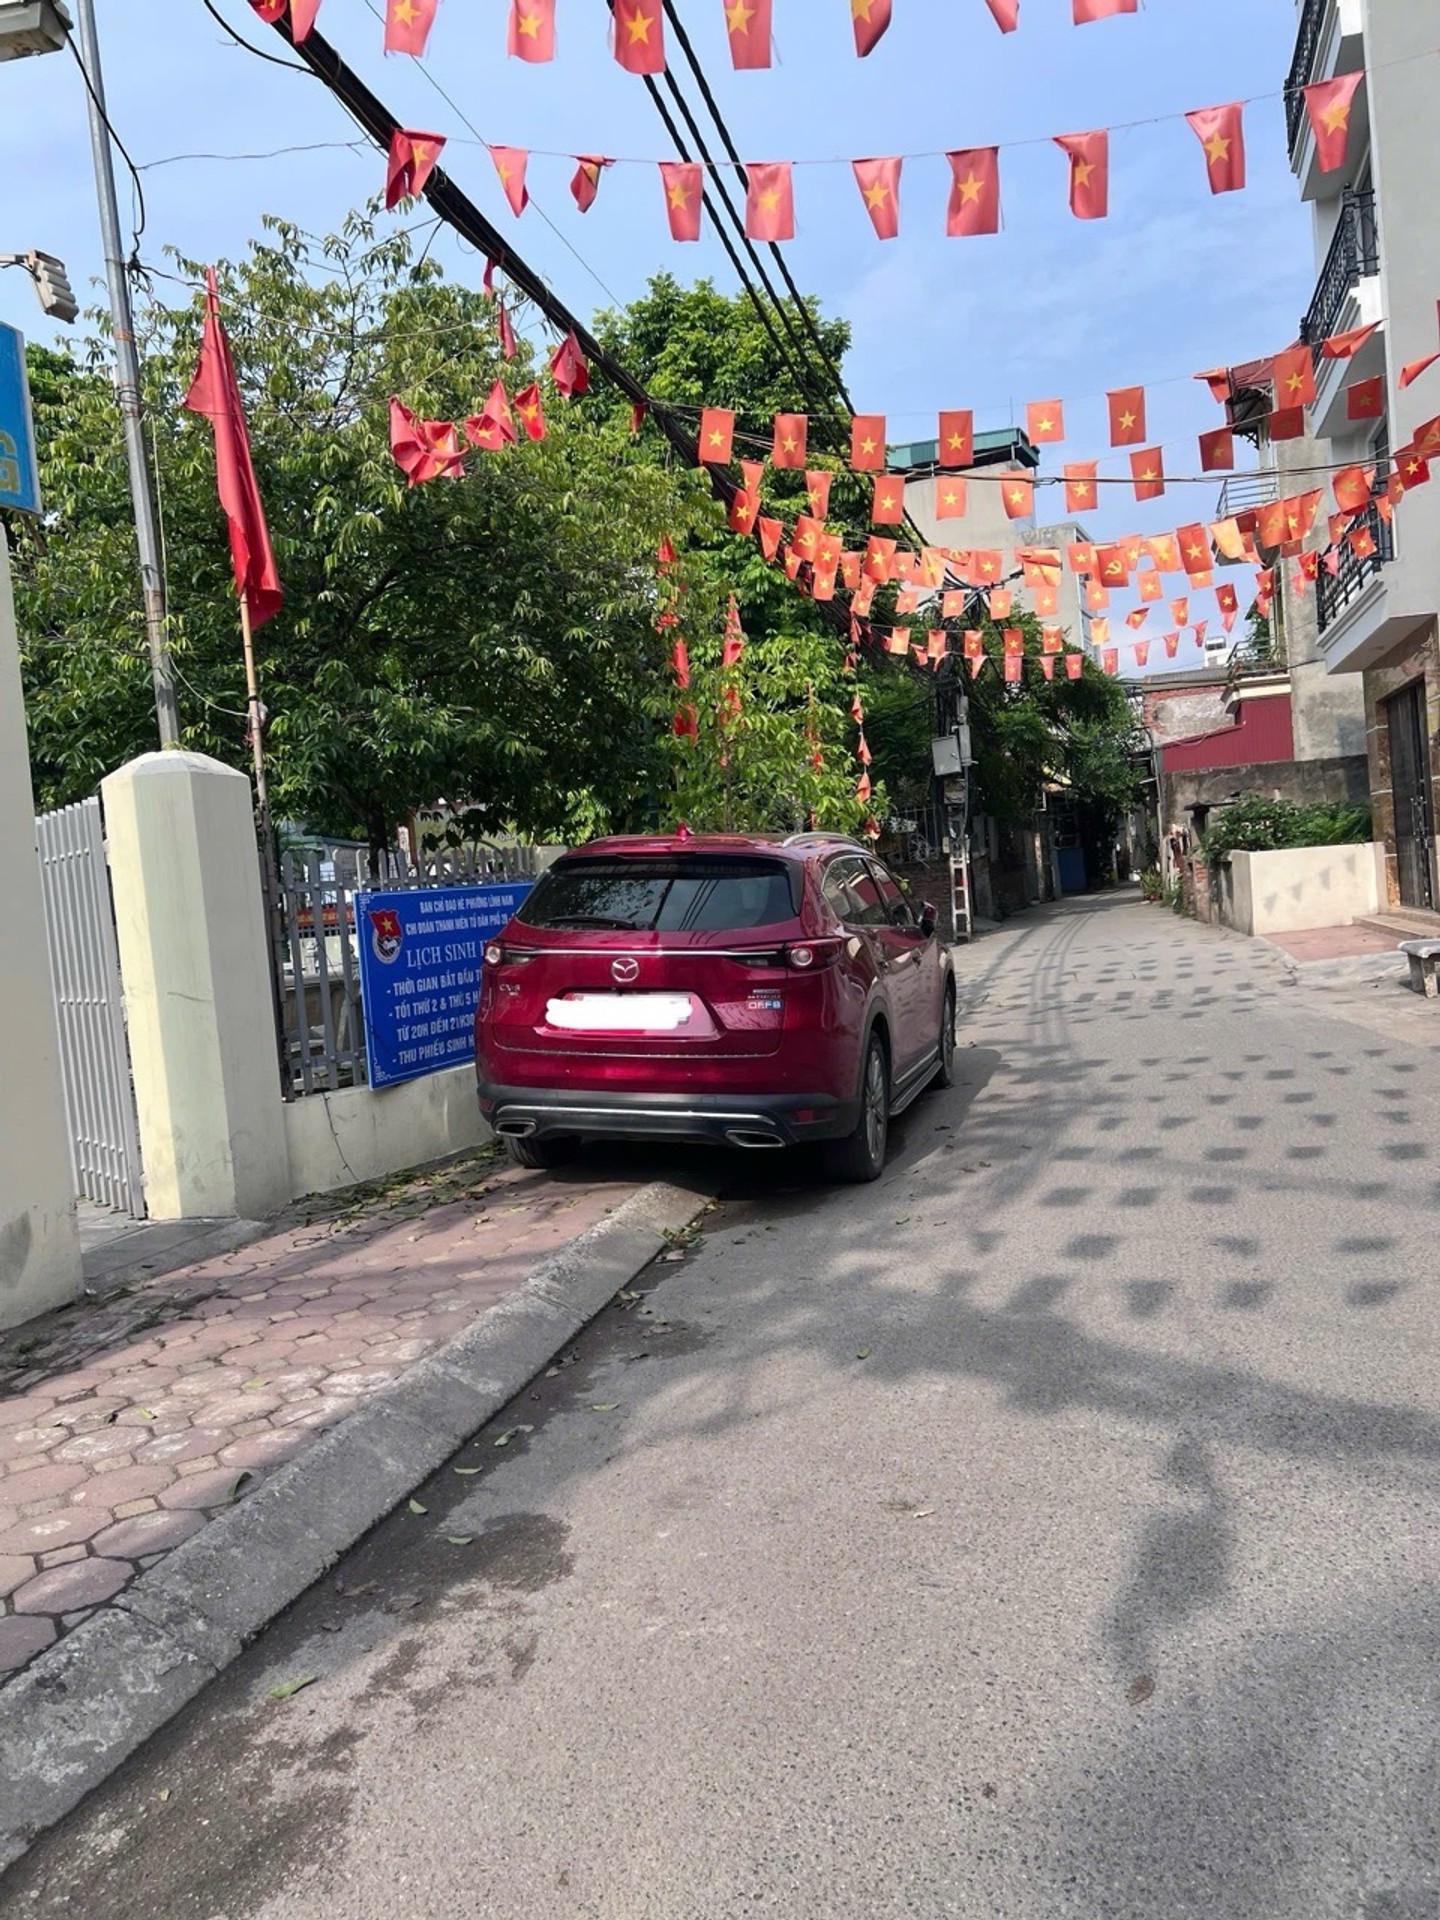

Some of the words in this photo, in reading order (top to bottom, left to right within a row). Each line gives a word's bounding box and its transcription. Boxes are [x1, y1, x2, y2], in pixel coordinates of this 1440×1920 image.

[406, 946, 442, 970] LỊCH
[444, 941, 477, 962] SINH
[393, 977, 416, 996] THỜI
[416, 976, 439, 992] GIAN
[440, 969, 456, 988] BẮT
[457, 966, 474, 985] ĐẦU
[395, 999, 411, 1019] TỐI
[413, 997, 430, 1016] THỨ
[431, 999, 438, 1012] 2
[440, 998, 447, 1011] &
[448, 992, 465, 1009] THỨ
[465, 992, 472, 1005] 5
[396, 1024, 409, 1042] TỪ
[411, 1023, 429, 1039] 20H
[430, 1016, 449, 1035] ĐẾN
[398, 1048, 417, 1065] THU
[418, 1038, 446, 1060] PHIẾU
[446, 1036, 467, 1053] SINH
